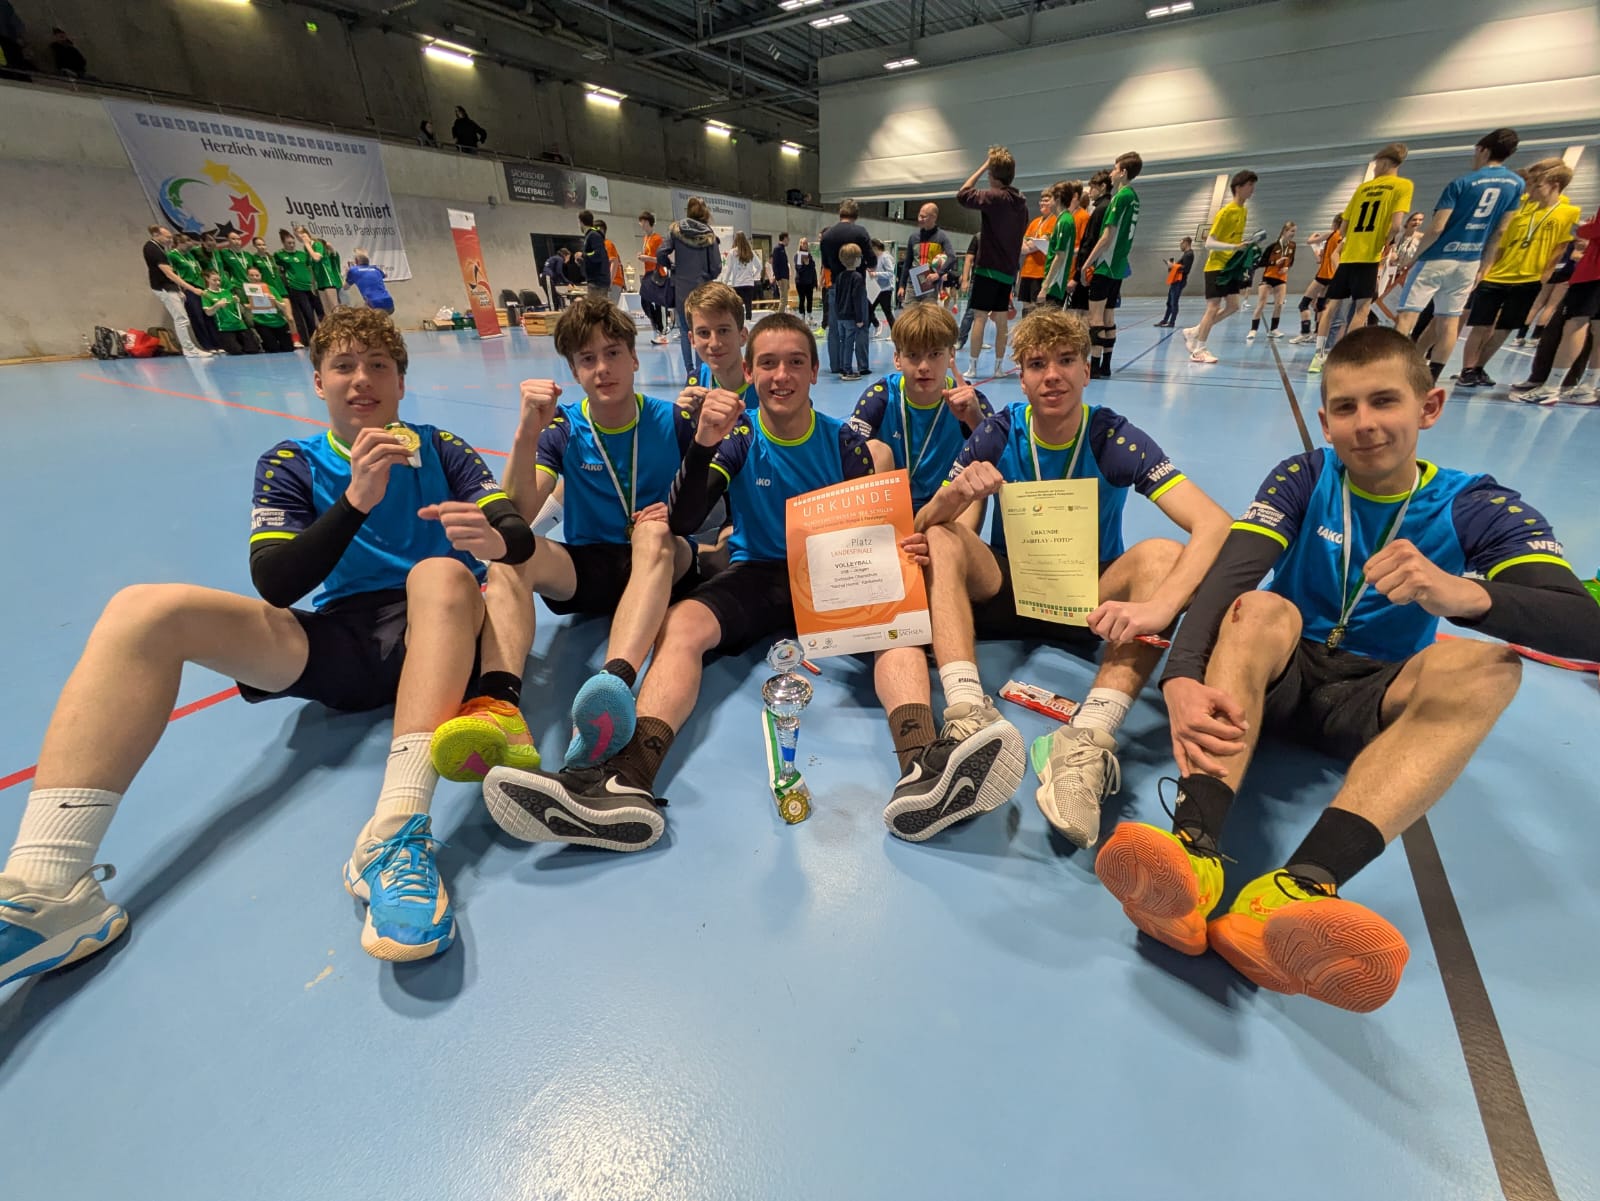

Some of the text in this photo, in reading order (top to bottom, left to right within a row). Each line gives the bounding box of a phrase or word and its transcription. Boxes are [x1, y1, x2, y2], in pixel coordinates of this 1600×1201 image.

[200, 138, 333, 166] Herzlich willkommen
[514, 186, 546, 196] VOLLEYBALL
[286, 197, 392, 219] Jugend trainiert
[1474, 188, 1500, 218] 9
[1354, 201, 1381, 232] 11
[309, 223, 344, 238] Olympia
[346, 223, 353, 236] &
[353, 224, 396, 238] Paralympics
[803, 490, 894, 517] URKUNDE
[851, 538, 872, 547] Platz
[1316, 525, 1343, 544] JAKO
[830, 547, 872, 557] LANDESFINALE
[834, 560, 872, 569] VOLLEYBALL
